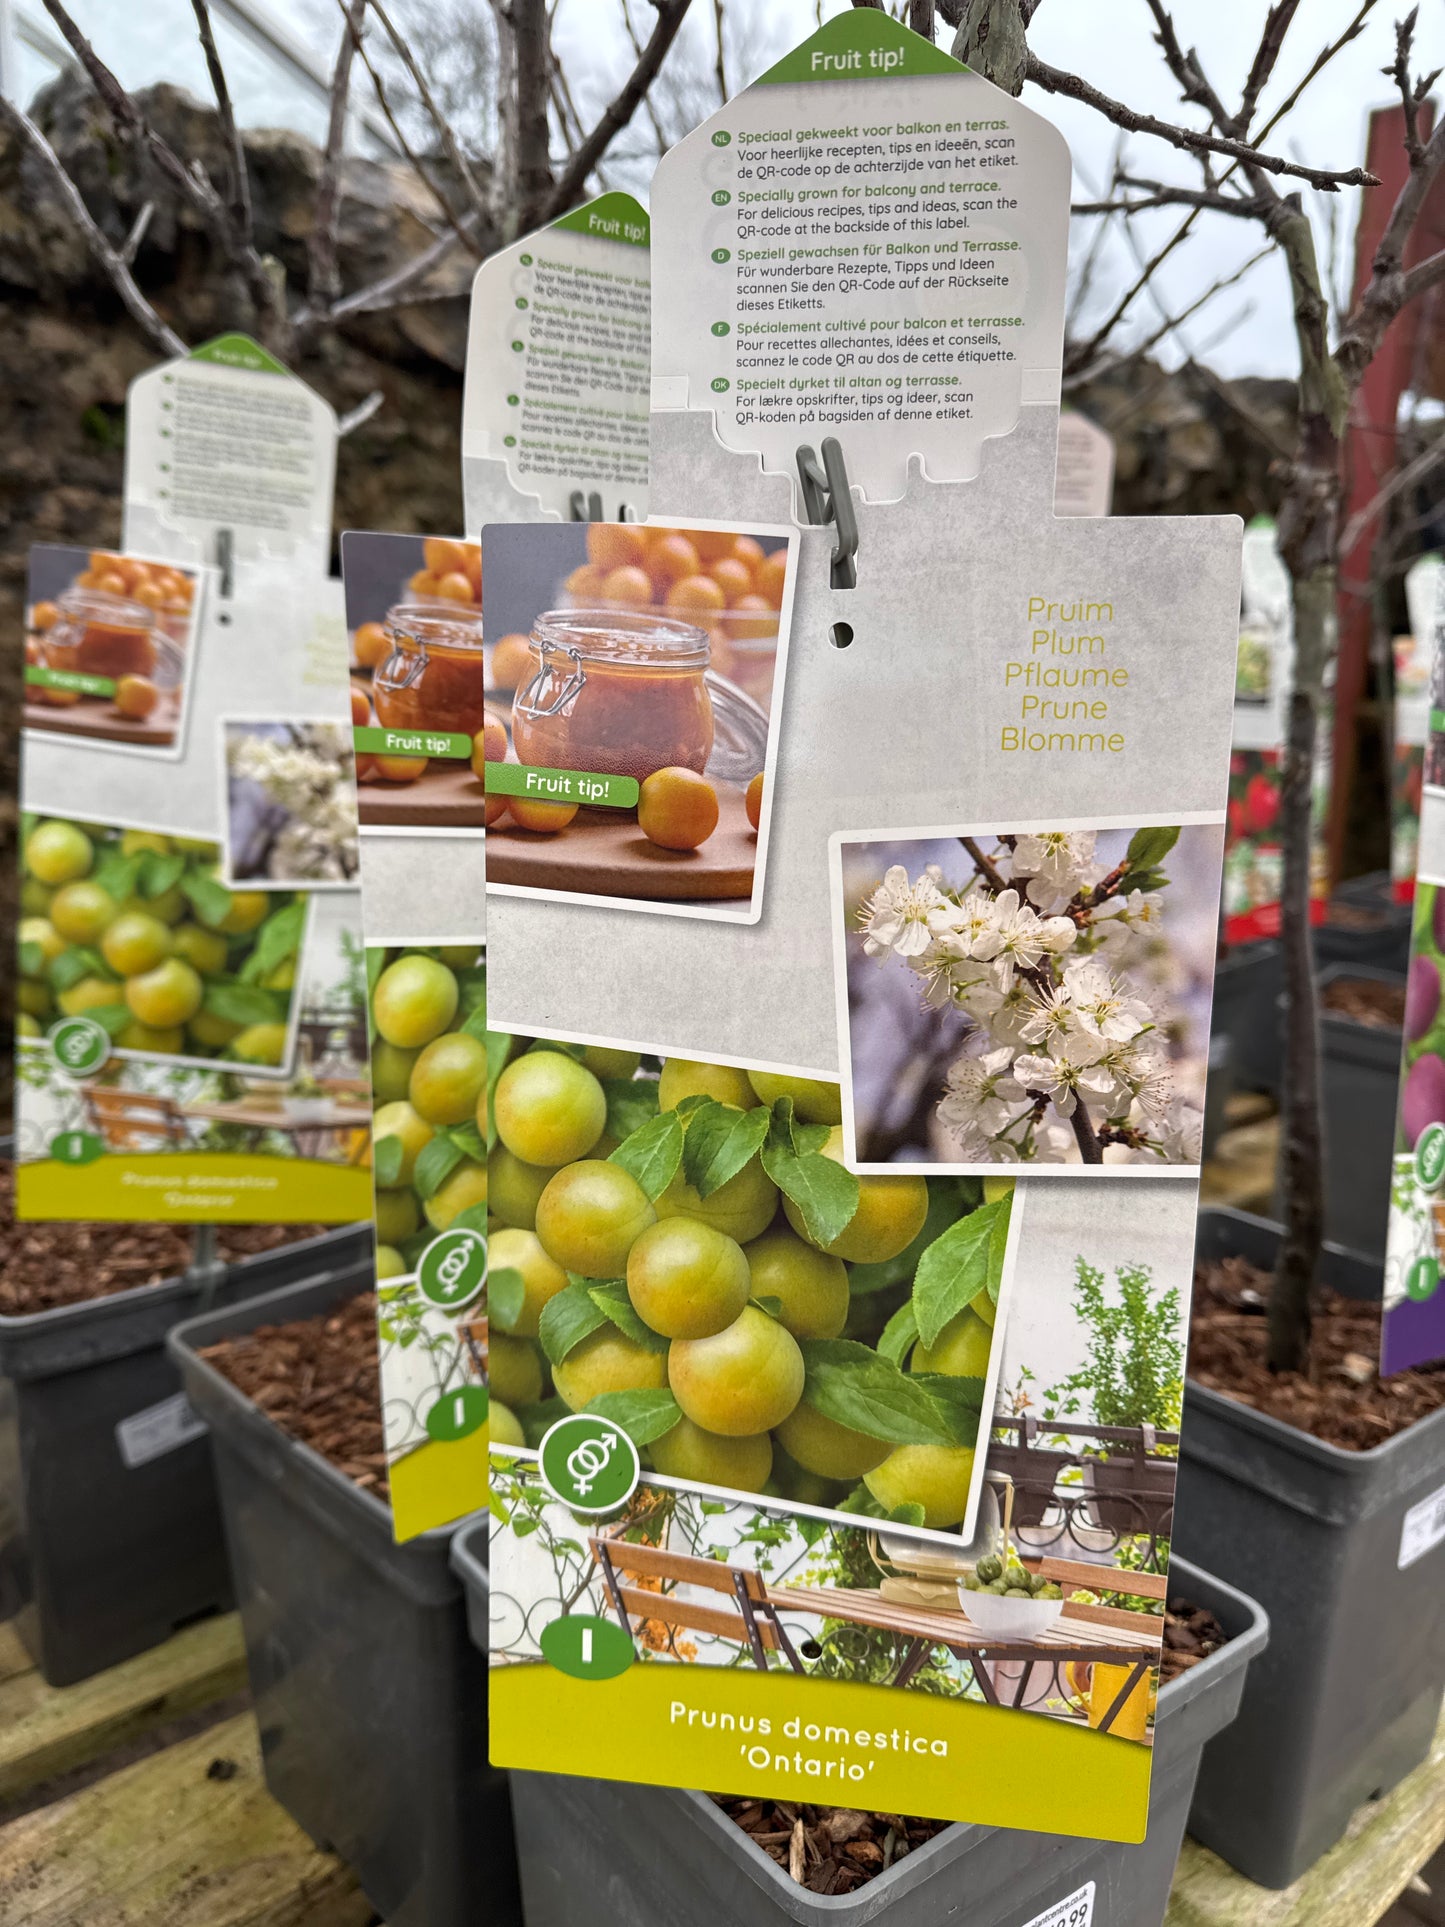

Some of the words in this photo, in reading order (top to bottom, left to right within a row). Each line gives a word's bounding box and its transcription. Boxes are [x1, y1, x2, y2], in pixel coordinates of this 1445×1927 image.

[811, 49, 862, 71] Fruit
[868, 46, 905, 72] tip!
[715, 135, 728, 143] NL
[738, 128, 792, 146] Speciaal
[795, 125, 859, 143] gekweekt
[862, 126, 893, 137] voor
[896, 121, 942, 135] balkon
[944, 122, 961, 133] en
[964, 120, 1009, 131] terras.
[736, 149, 768, 161] Voor
[770, 145, 823, 161] heerlijke
[826, 144, 886, 159] recepten,
[888, 141, 912, 156] tips
[914, 142, 931, 153] en
[934, 138, 981, 152] ideeën,
[984, 138, 1015, 149] scan
[737, 166, 753, 179] de
[756, 163, 811, 180] QR-code
[814, 165, 831, 177] op
[834, 161, 850, 174] de
[853, 158, 924, 174] achterzijde
[927, 159, 951, 170] van
[954, 155, 976, 168] het
[978, 154, 1018, 167] etiket.
[715, 194, 728, 202] EN
[738, 188, 794, 205] Specially
[797, 188, 838, 203] grown
[841, 185, 862, 198] for
[864, 184, 916, 198] balcony
[919, 181, 945, 195] and
[948, 181, 1001, 193] terrace.
[737, 208, 758, 220] For
[760, 206, 814, 219] delicious
[817, 204, 865, 219] recipes,
[868, 203, 891, 217] tips
[894, 200, 919, 214] and
[922, 199, 960, 213] ideas,
[962, 200, 993, 211] scan
[996, 197, 1018, 209] the
[589, 213, 620, 236] Fruit
[736, 223, 791, 240] QR-code
[794, 223, 808, 235] at
[810, 221, 831, 234] the
[834, 219, 890, 233] backside
[892, 218, 907, 231] of
[910, 217, 932, 230] this
[936, 215, 970, 229] label.
[717, 252, 724, 260] D
[737, 247, 785, 263] Speziell
[788, 245, 859, 262] gewachsen
[862, 243, 882, 256] für
[886, 242, 930, 255] Balkon
[934, 240, 958, 254] und
[962, 240, 1021, 252] Terrasse.
[737, 266, 757, 278] Für
[759, 263, 834, 277] wunderbare
[837, 262, 891, 276] Rezepte,
[894, 260, 928, 275] Tipps
[932, 258, 956, 271] und
[959, 257, 994, 270] Ideen
[736, 283, 787, 295] scannen
[790, 280, 809, 293] Sie
[811, 279, 835, 292] den
[838, 277, 896, 294] QR-Code
[898, 276, 920, 289] auf
[922, 276, 945, 288] der
[948, 274, 1009, 287] Rückseite
[736, 299, 774, 311] dieses
[778, 297, 825, 310] Etiketts.
[718, 325, 723, 333] F
[736, 321, 822, 337] Spécialement
[824, 318, 866, 332] cultivé
[870, 320, 900, 333] pour
[903, 317, 947, 330] balcon
[950, 317, 964, 328] et
[967, 317, 1025, 328] terrasse.
[736, 339, 764, 351] Pour
[767, 338, 817, 350] recettes
[819, 336, 893, 349] allechantes,
[896, 334, 929, 347] idées
[932, 335, 945, 346] et
[948, 332, 1001, 346] conseils,
[736, 357, 785, 367] scannez
[788, 354, 799, 366] le
[802, 353, 832, 366] code
[835, 353, 854, 367] QR
[857, 355, 874, 365] au
[876, 351, 899, 364] dos
[902, 351, 918, 363] de
[921, 351, 954, 363] cette
[956, 349, 1016, 364] étiquette.
[714, 381, 727, 389] DK
[736, 377, 786, 393] Specielt
[788, 376, 830, 392] dyrket
[832, 375, 846, 388] til
[848, 375, 882, 388] altan
[885, 377, 902, 390] og
[905, 375, 962, 386] terrasse.
[736, 395, 756, 407] For
[759, 394, 793, 407] lækre
[796, 393, 858, 408] opskrifter,
[861, 393, 884, 407] tips
[886, 394, 903, 407] og
[906, 391, 941, 404] ideer,
[944, 393, 973, 403] scan
[735, 410, 796, 426] QR-koden
[799, 409, 815, 425] på
[818, 409, 874, 424] bagsiden
[877, 408, 891, 421] af
[893, 408, 932, 420] denne
[935, 407, 973, 420] etiket.
[1028, 597, 1114, 621] Pruim
[1032, 629, 1104, 654] Plum
[1005, 662, 1129, 687] Pflaume
[1022, 695, 1108, 720] Prune
[385, 733, 422, 751] Fruit
[426, 737, 451, 755] tip!
[1001, 726, 1125, 752] Blomme
[526, 772, 571, 794] Fruit
[578, 779, 610, 801] tip!
[670, 1700, 772, 1735] Prunus
[783, 1716, 949, 1757] domestica
[740, 1744, 875, 1781] 'Ontario'
